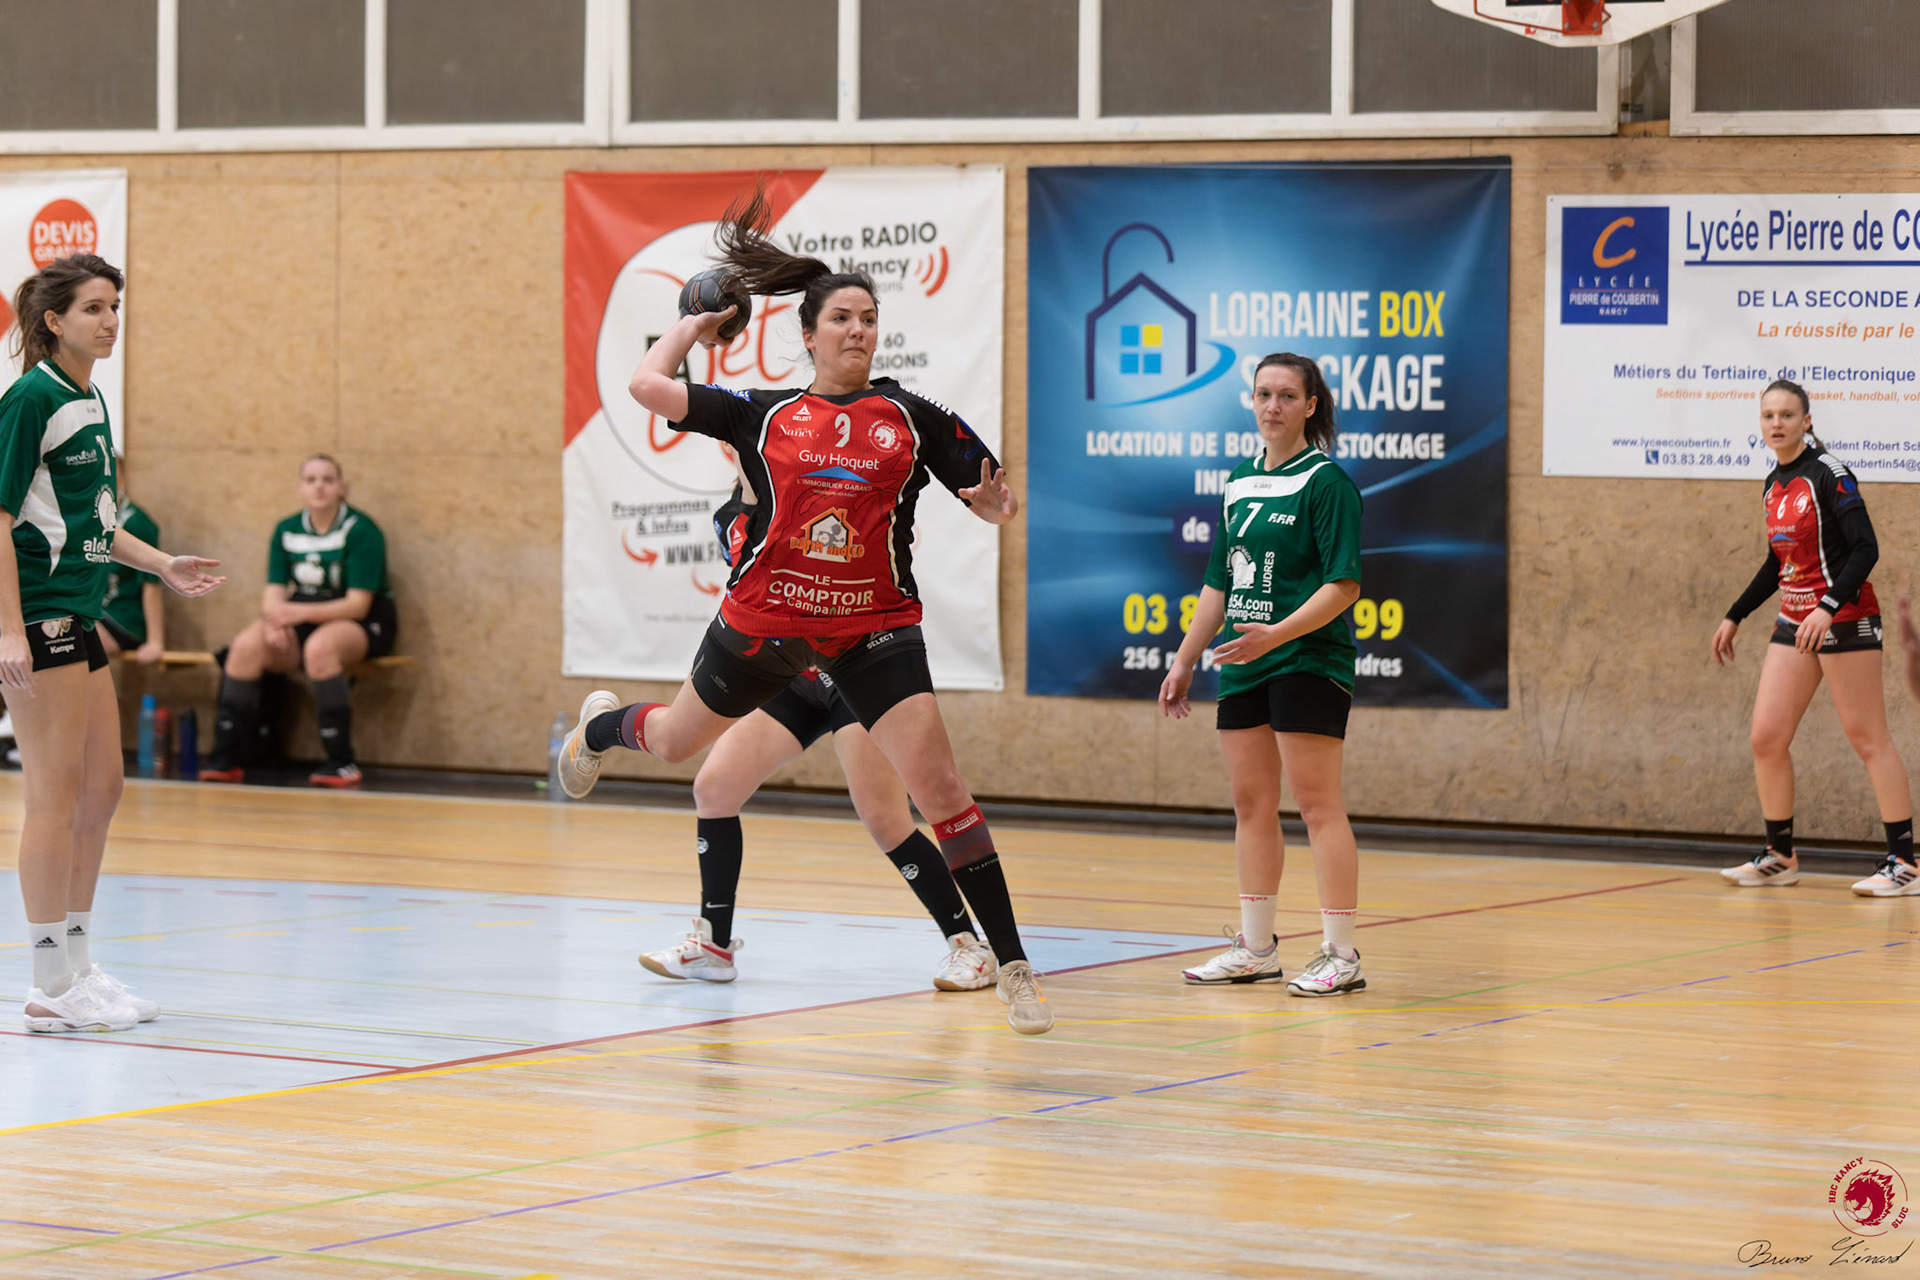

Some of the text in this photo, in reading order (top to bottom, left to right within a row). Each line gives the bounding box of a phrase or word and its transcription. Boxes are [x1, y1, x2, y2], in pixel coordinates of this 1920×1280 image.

[34, 219, 95, 245] DEVIS
[788, 221, 937, 253] Votre RADIO
[1592, 216, 1636, 268] C
[1686, 209, 1759, 262] Lycée
[1769, 210, 1844, 251] Pierre
[1853, 210, 1883, 251] de
[839, 256, 910, 281] Nancy
[1578, 273, 1651, 288] LYCÉE
[1569, 292, 1659, 306] PIERRE de COUBERTIN
[1737, 290, 1765, 308] DE
[1773, 290, 1799, 308] LA
[1805, 290, 1908, 308] SECONDE
[1210, 291, 1445, 337] LORRAINE BOX
[884, 333, 905, 348] 60
[1757, 321, 1915, 342] La réussite par le
[1613, 363, 1916, 385] Métiers du Tertiaire, de l'Electronique
[1655, 387, 1702, 399] Sections
[1705, 389, 1756, 401] sportives
[1850, 391, 1901, 403] handball,
[834, 412, 851, 448] 9
[1086, 431, 1183, 457] LOCATION
[1190, 432, 1218, 458] DE
[1336, 432, 1445, 459] STOCKAGE
[1612, 436, 1731, 448] www.lyceecoubertin.fr
[1863, 440, 1900, 451] Robert
[799, 449, 880, 471] Guy Hoquet
[1662, 453, 1751, 466] 03.83.28.49.49
[612, 499, 711, 517] Programmes
[1777, 494, 1789, 520] 6
[636, 515, 690, 536] & Infos
[1182, 515, 1211, 543] de
[1236, 501, 1264, 538] 7
[815, 574, 831, 586] LE
[1262, 551, 1276, 594] LUDRES
[768, 580, 874, 606] COMPTOIR
[787, 596, 852, 616] Campanile
[1123, 593, 1169, 635] 03
[1353, 598, 1404, 641] 99
[50, 643, 75, 655] Kempa
[866, 632, 895, 649] SELECT
[1123, 646, 1161, 671] 256
